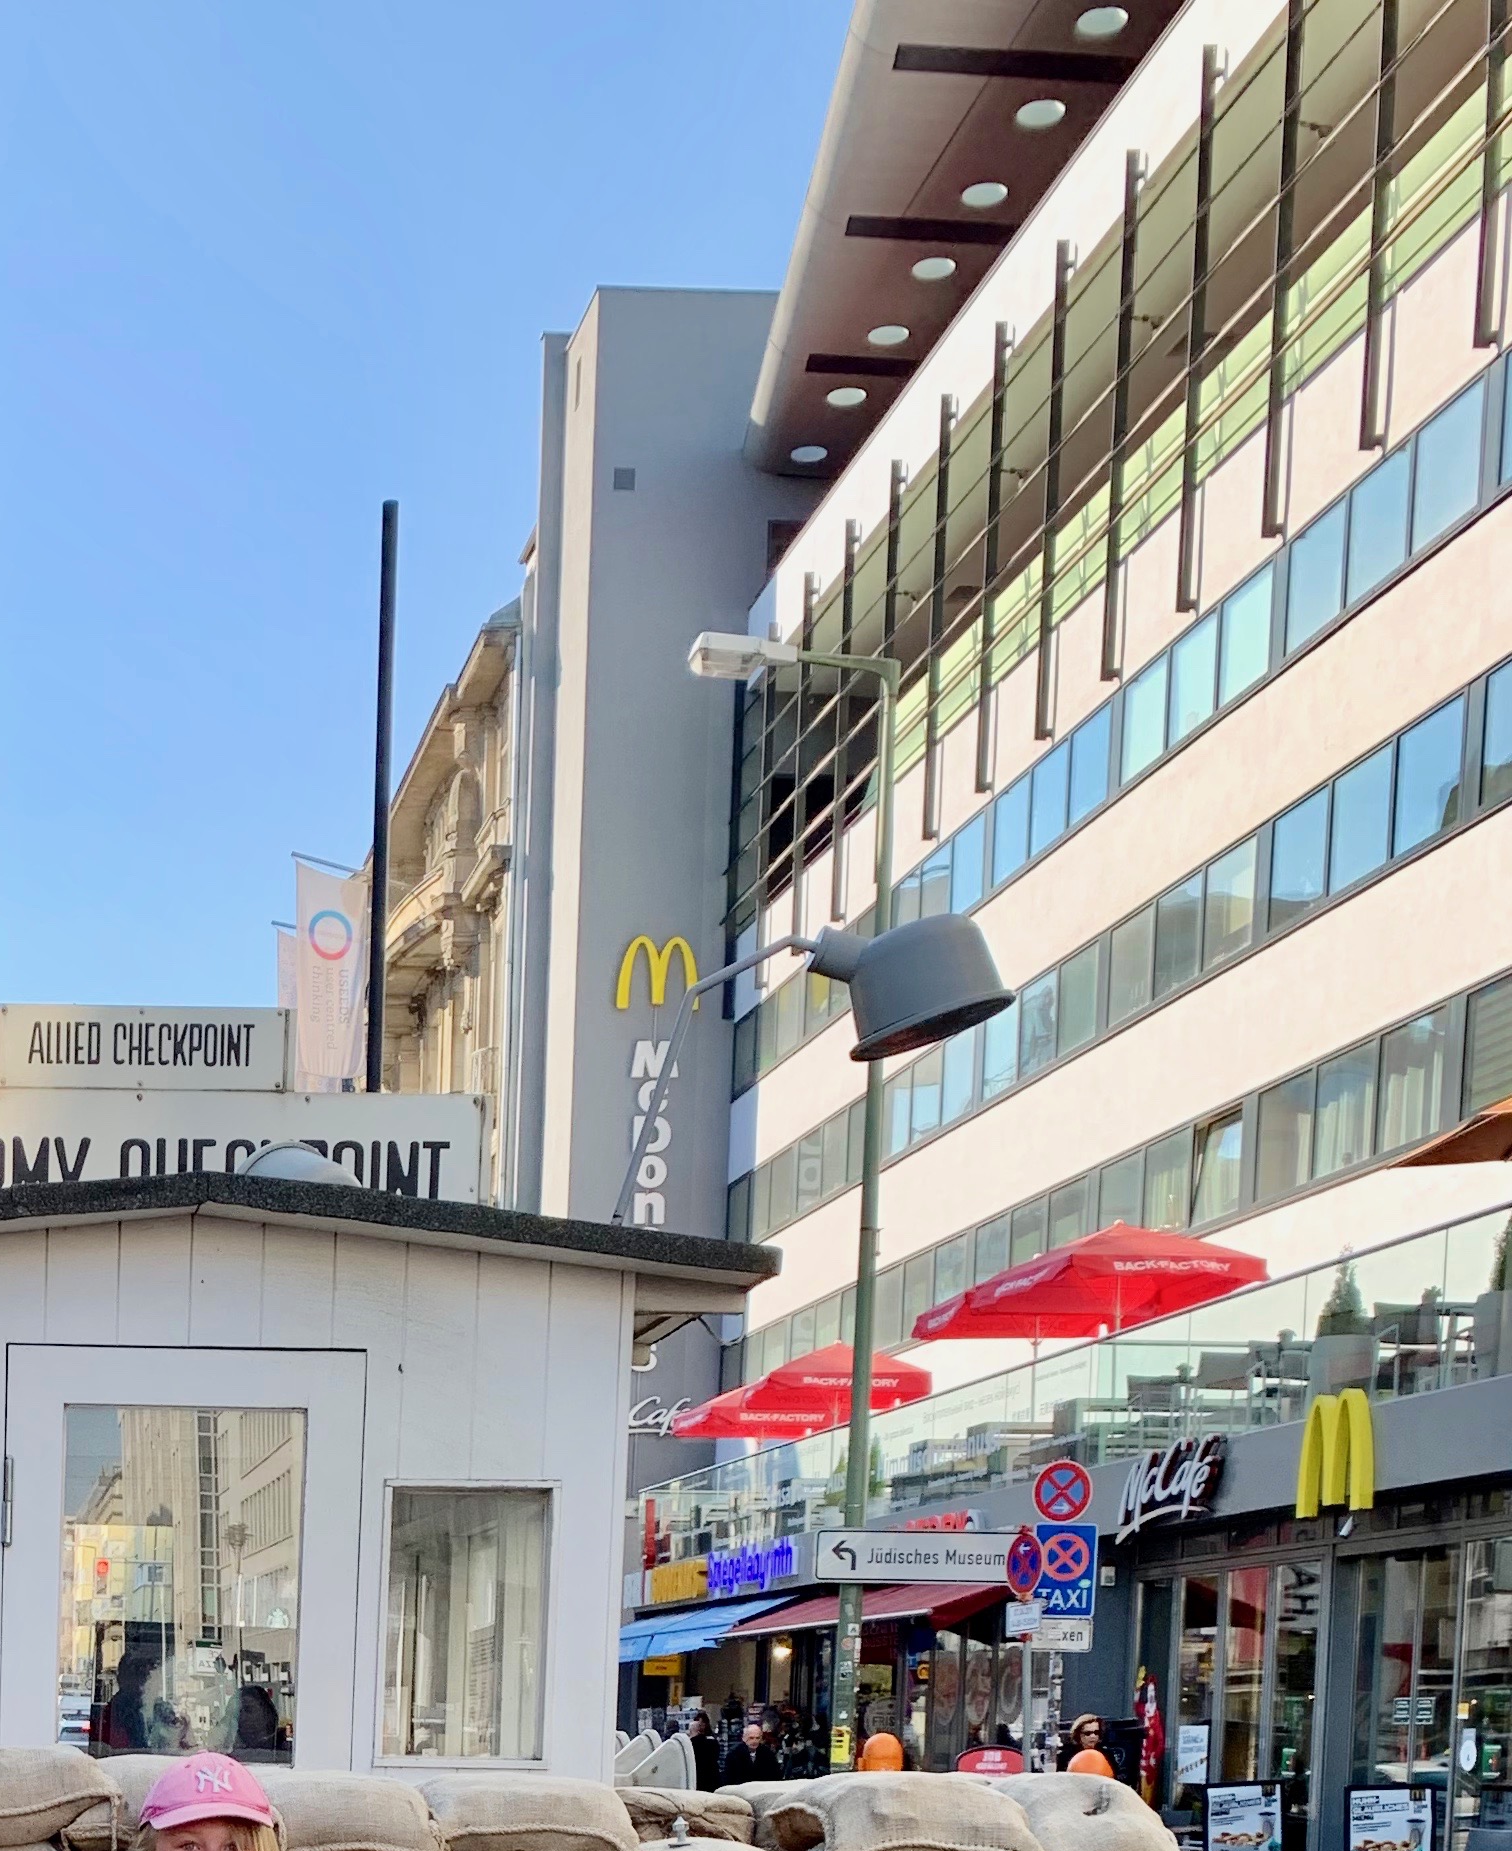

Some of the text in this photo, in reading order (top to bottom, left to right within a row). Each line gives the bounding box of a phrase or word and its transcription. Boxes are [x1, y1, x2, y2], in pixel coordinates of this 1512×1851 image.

[28, 1020, 256, 1067] ALLIED CHECKPOINT
[1118, 1434, 1218, 1530] McCafé
[867, 1547, 1007, 1568] Jüdisches Museum
[1037, 1588, 1088, 1609] TAXI
